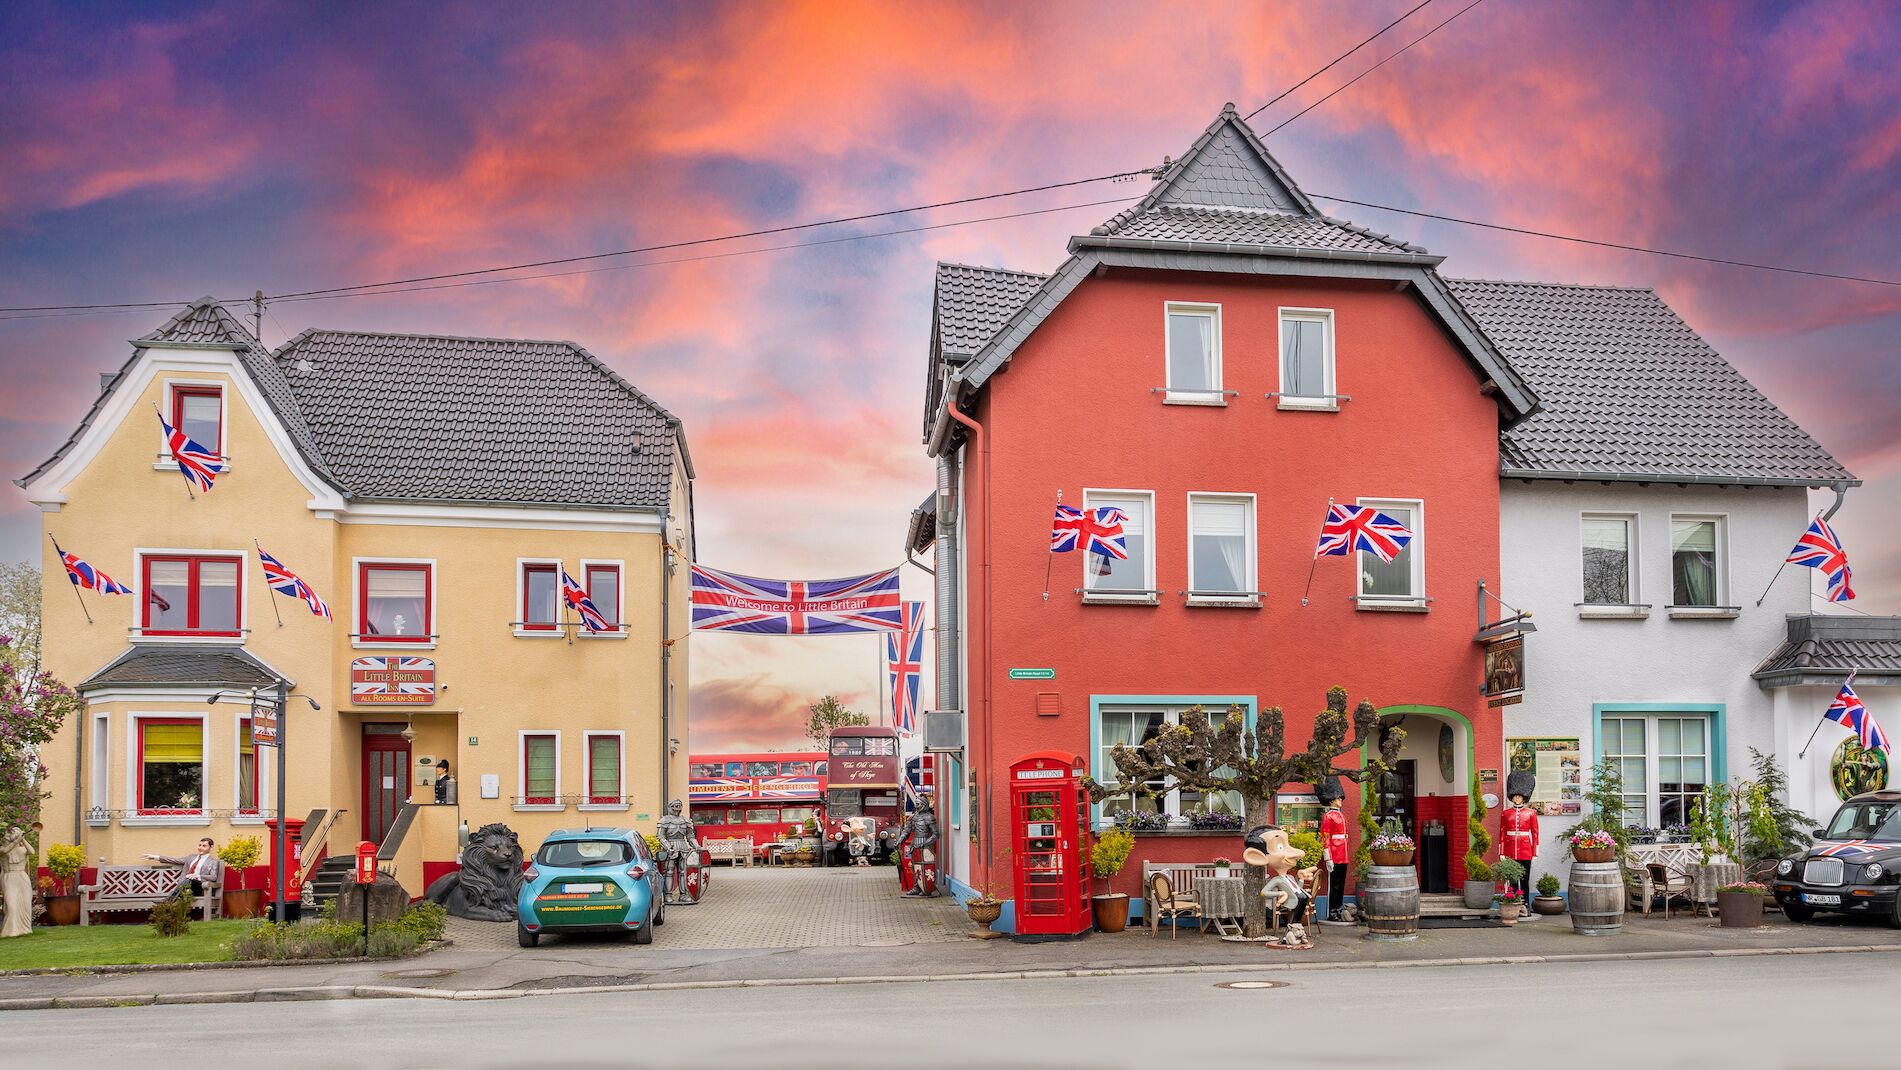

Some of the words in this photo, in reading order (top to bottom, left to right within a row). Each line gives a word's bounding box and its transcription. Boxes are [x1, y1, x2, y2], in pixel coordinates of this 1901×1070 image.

[725, 595, 780, 612] Welcome
[783, 603, 795, 612] to
[798, 600, 827, 612] Little
[830, 598, 868, 611] Britain
[364, 671, 390, 681] LITTLE
[393, 671, 423, 681] BRITAIN
[387, 683, 399, 692] INN
[842, 761, 855, 769] The
[856, 761, 869, 769] Old
[850, 770, 860, 780] of
[1018, 770, 1063, 778] TELEPHONE
